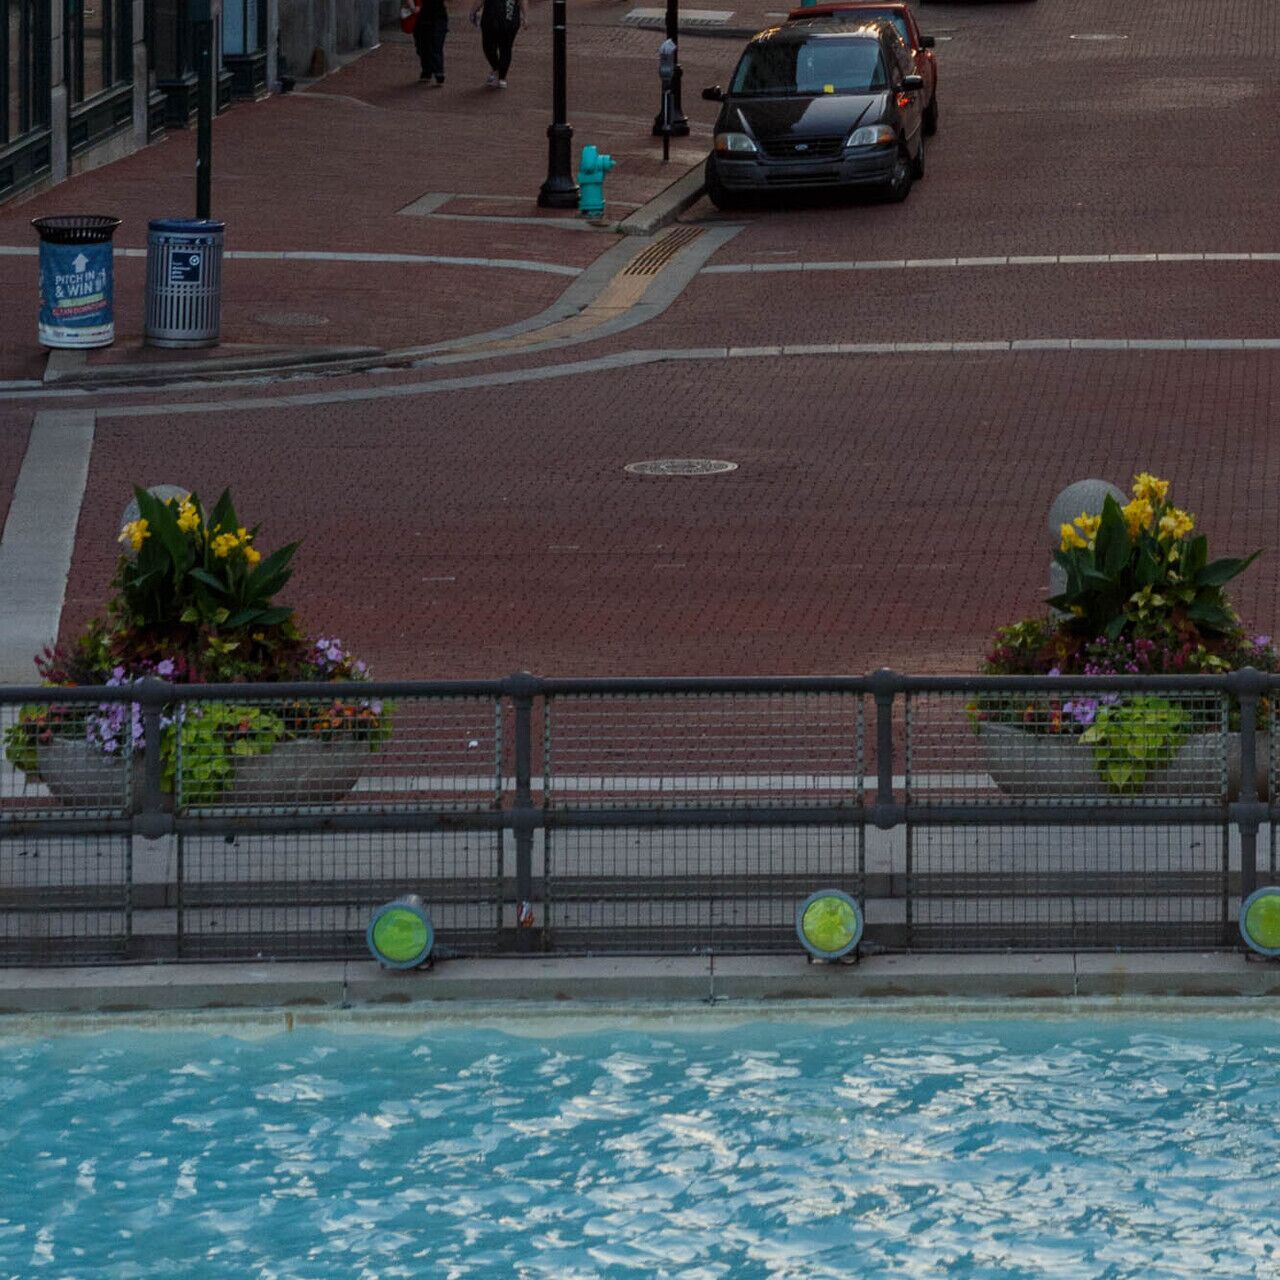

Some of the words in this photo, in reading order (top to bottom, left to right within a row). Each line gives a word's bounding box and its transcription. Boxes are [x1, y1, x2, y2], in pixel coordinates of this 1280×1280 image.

[55, 273, 84, 285] PITCH
[84, 270, 95, 280] IN
[55, 286, 65, 298] &
[67, 281, 93, 296] WIN
